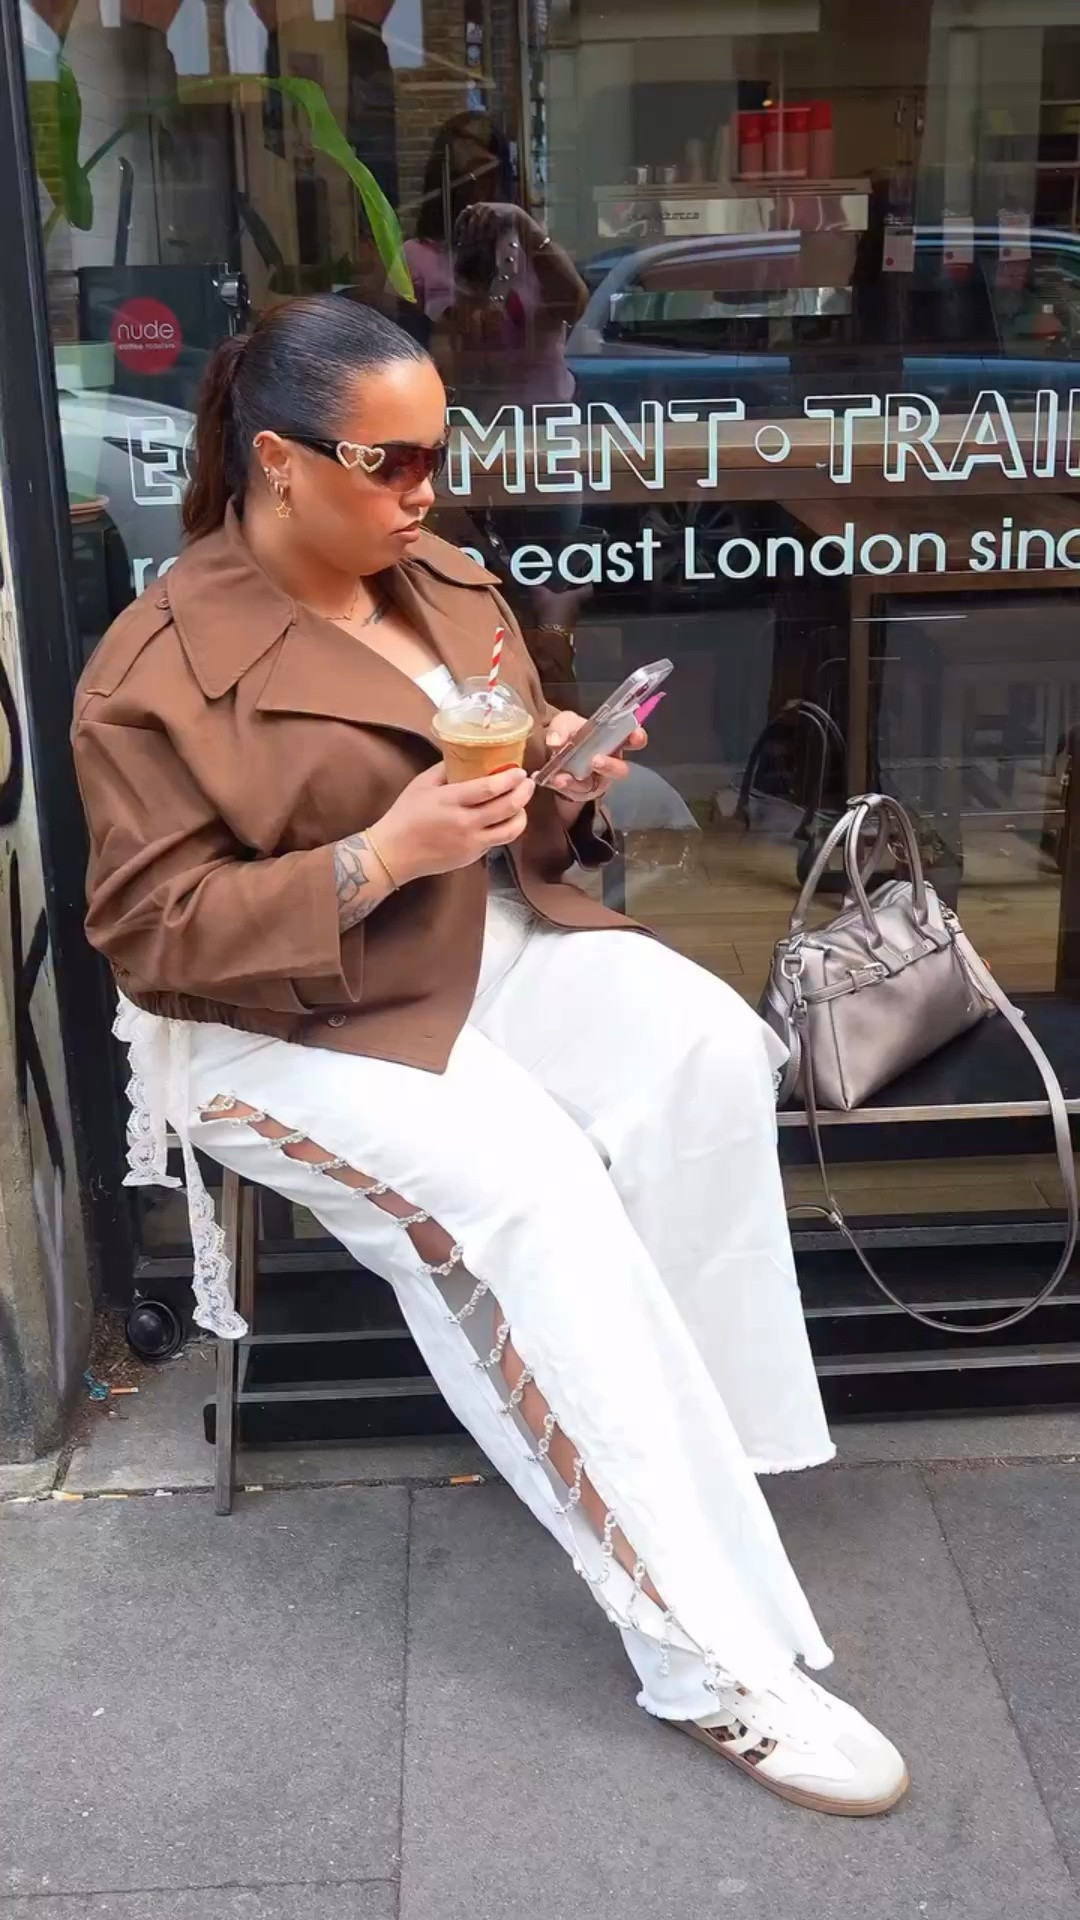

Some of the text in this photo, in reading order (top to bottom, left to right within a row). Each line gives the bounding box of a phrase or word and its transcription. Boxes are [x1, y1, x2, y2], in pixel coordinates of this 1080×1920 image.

[117, 319, 175, 340] nude
[126, 388, 1080, 507] EMENT TRAI
[509, 527, 662, 586] east
[684, 521, 947, 580] London
